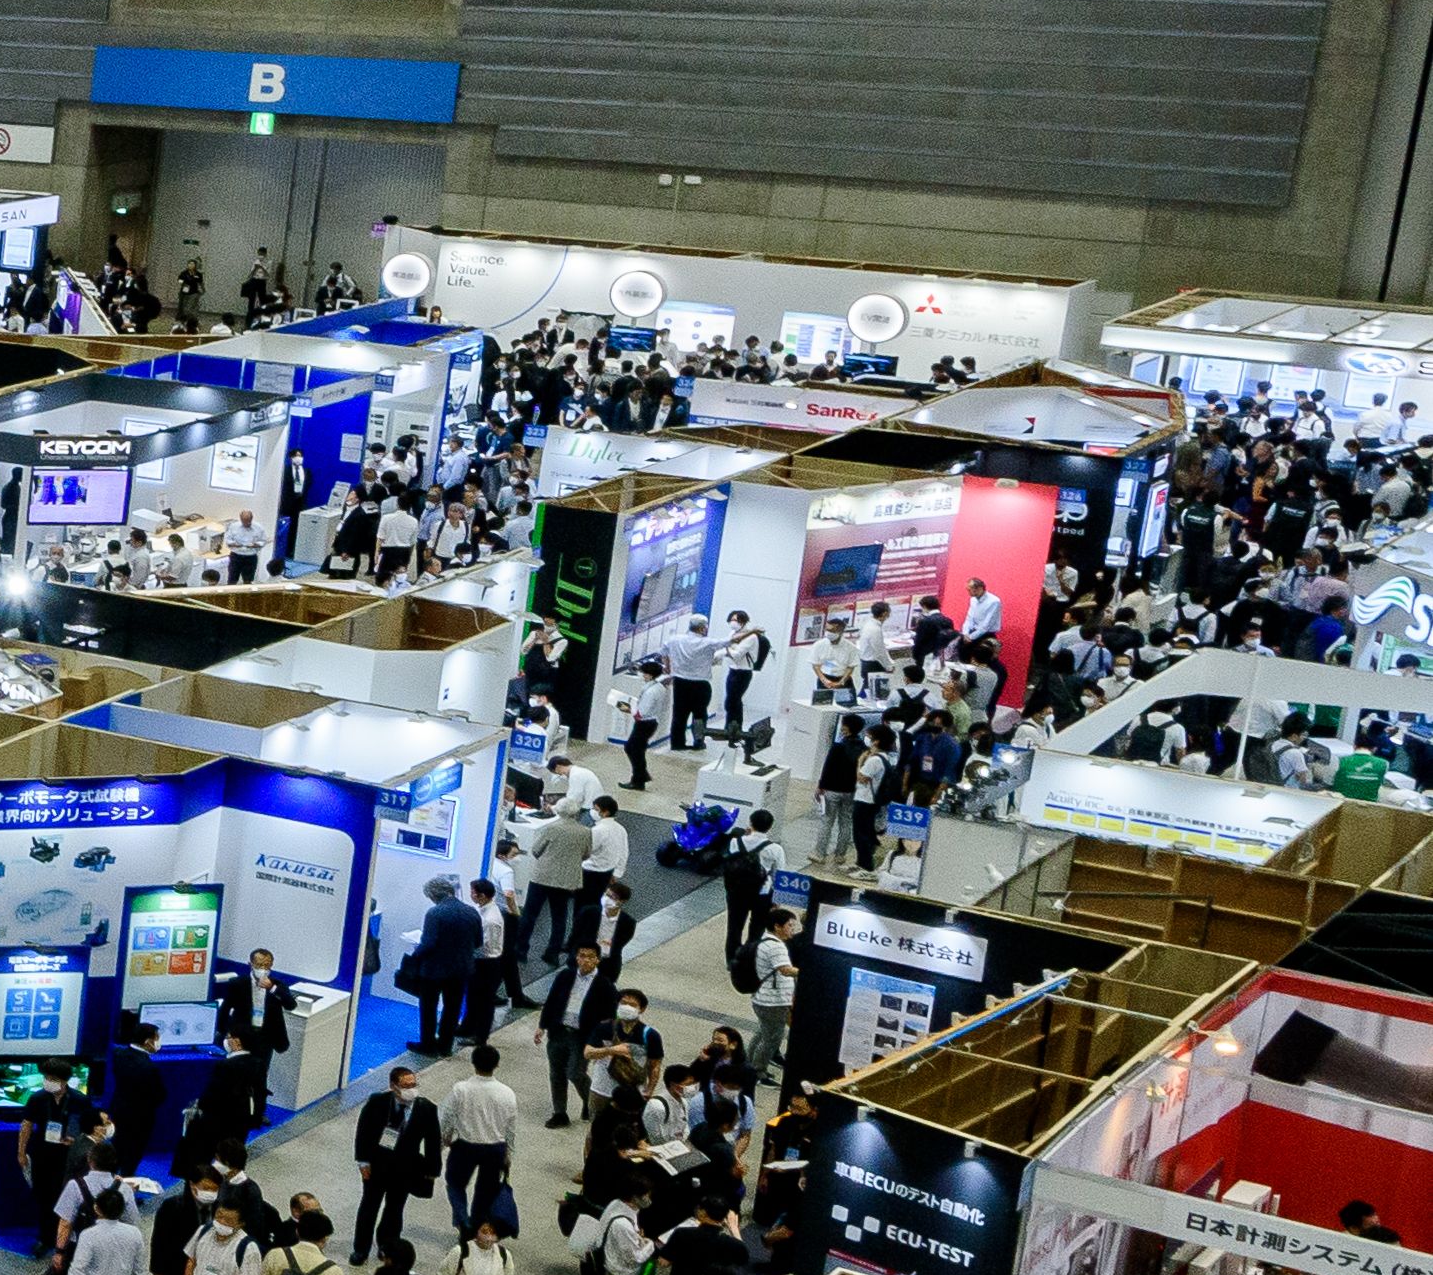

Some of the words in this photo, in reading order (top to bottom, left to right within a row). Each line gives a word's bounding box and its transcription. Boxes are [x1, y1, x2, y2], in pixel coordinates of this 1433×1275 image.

[248, 63, 286, 103] B
[449, 250, 508, 266] Science.
[449, 263, 490, 277] Value.
[447, 275, 476, 288] Life.
[807, 401, 878, 422] SanRex
[40, 440, 131, 455] KEYCOM
[566, 436, 626, 462] Dylec
[1060, 489, 1084, 502] 326
[514, 734, 542, 748] 320
[380, 794, 408, 807] 319
[892, 808, 924, 823] 339
[255, 853, 341, 882] Kokusai
[255, 871, 335, 896] 国際計測器株式会社
[778, 876, 811, 893] 340
[827, 920, 893, 949] Blueke
[897, 937, 975, 967] 株式会社
[833, 1159, 986, 1227] 車載ECUのテスト自動化
[885, 1223, 976, 1269] ECU-TEST
